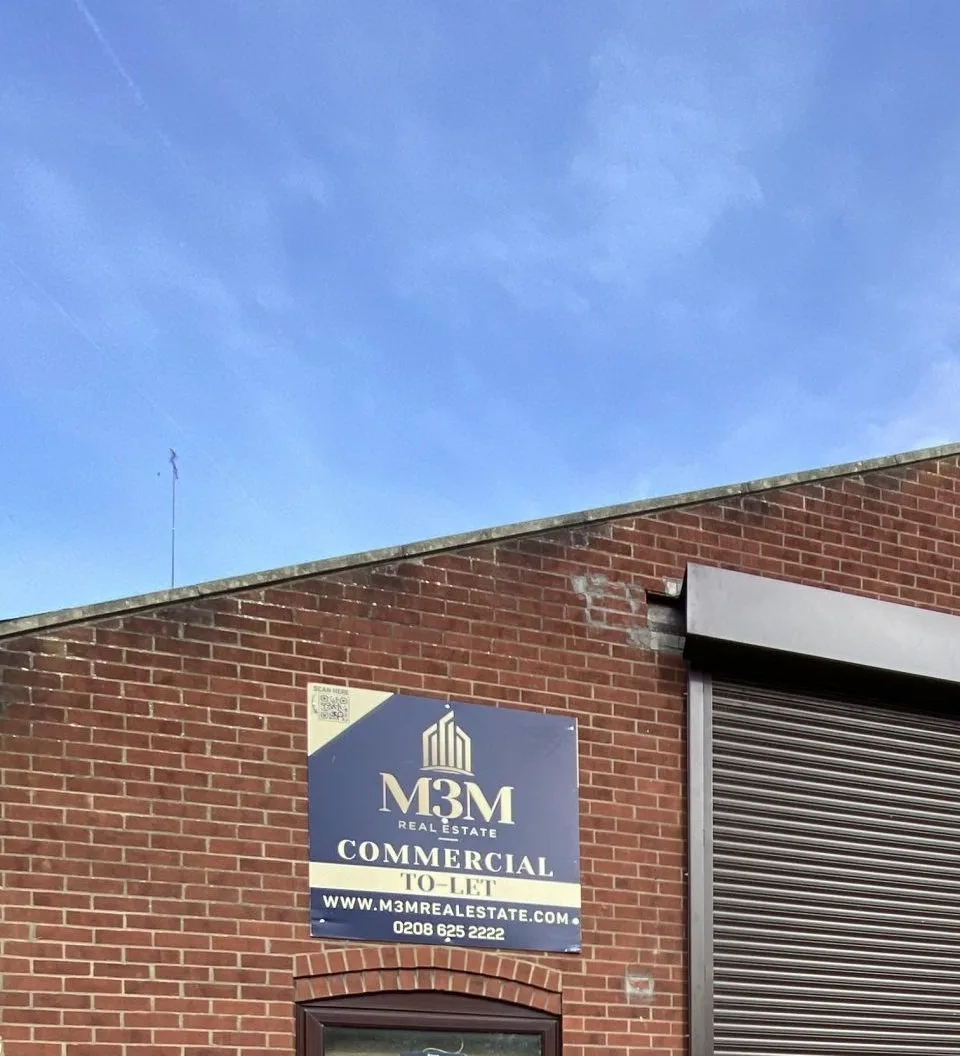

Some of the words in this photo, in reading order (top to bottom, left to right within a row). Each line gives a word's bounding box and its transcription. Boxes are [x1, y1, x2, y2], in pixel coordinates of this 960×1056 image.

[313, 685, 331, 693] SCAN
[333, 687, 349, 695] HERE
[378, 772, 516, 825] M3M
[398, 820, 437, 833] REAL
[442, 825, 497, 838] ESTATE
[337, 839, 554, 877] COMMERCIAL
[400, 872, 496, 897] TO-LET
[322, 895, 569, 925] WWW.M3MREALESTATE.COM
[393, 921, 433, 936] 0208
[437, 923, 465, 938] 625
[468, 925, 505, 941] 2222
